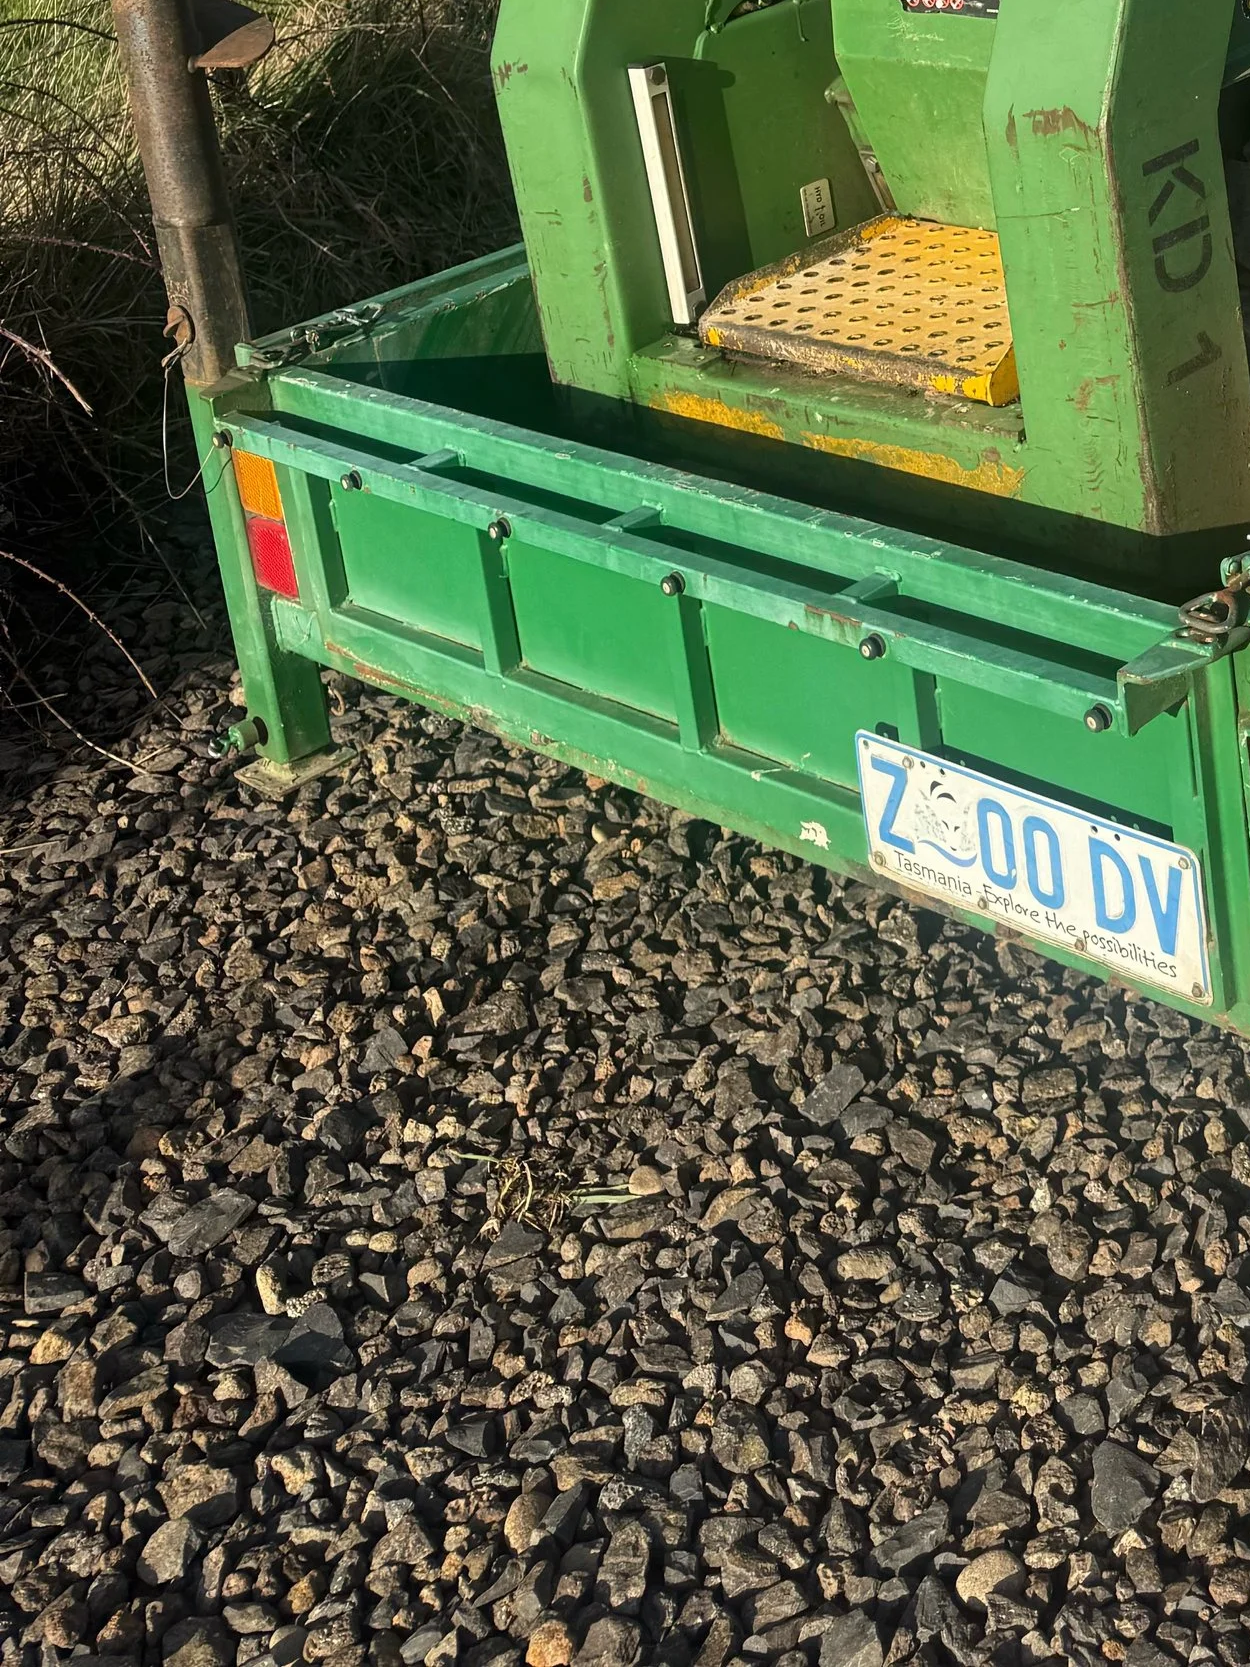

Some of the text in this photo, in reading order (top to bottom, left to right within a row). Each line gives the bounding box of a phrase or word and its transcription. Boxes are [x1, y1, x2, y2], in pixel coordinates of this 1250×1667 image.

[870, 755, 915, 854] Z
[1088, 835, 1182, 956] DV
[894, 850, 972, 896] Tasmania
[983, 883, 1040, 923] Explore
[1045, 909, 1076, 937] the
[1083, 929, 1177, 978] possibilities
